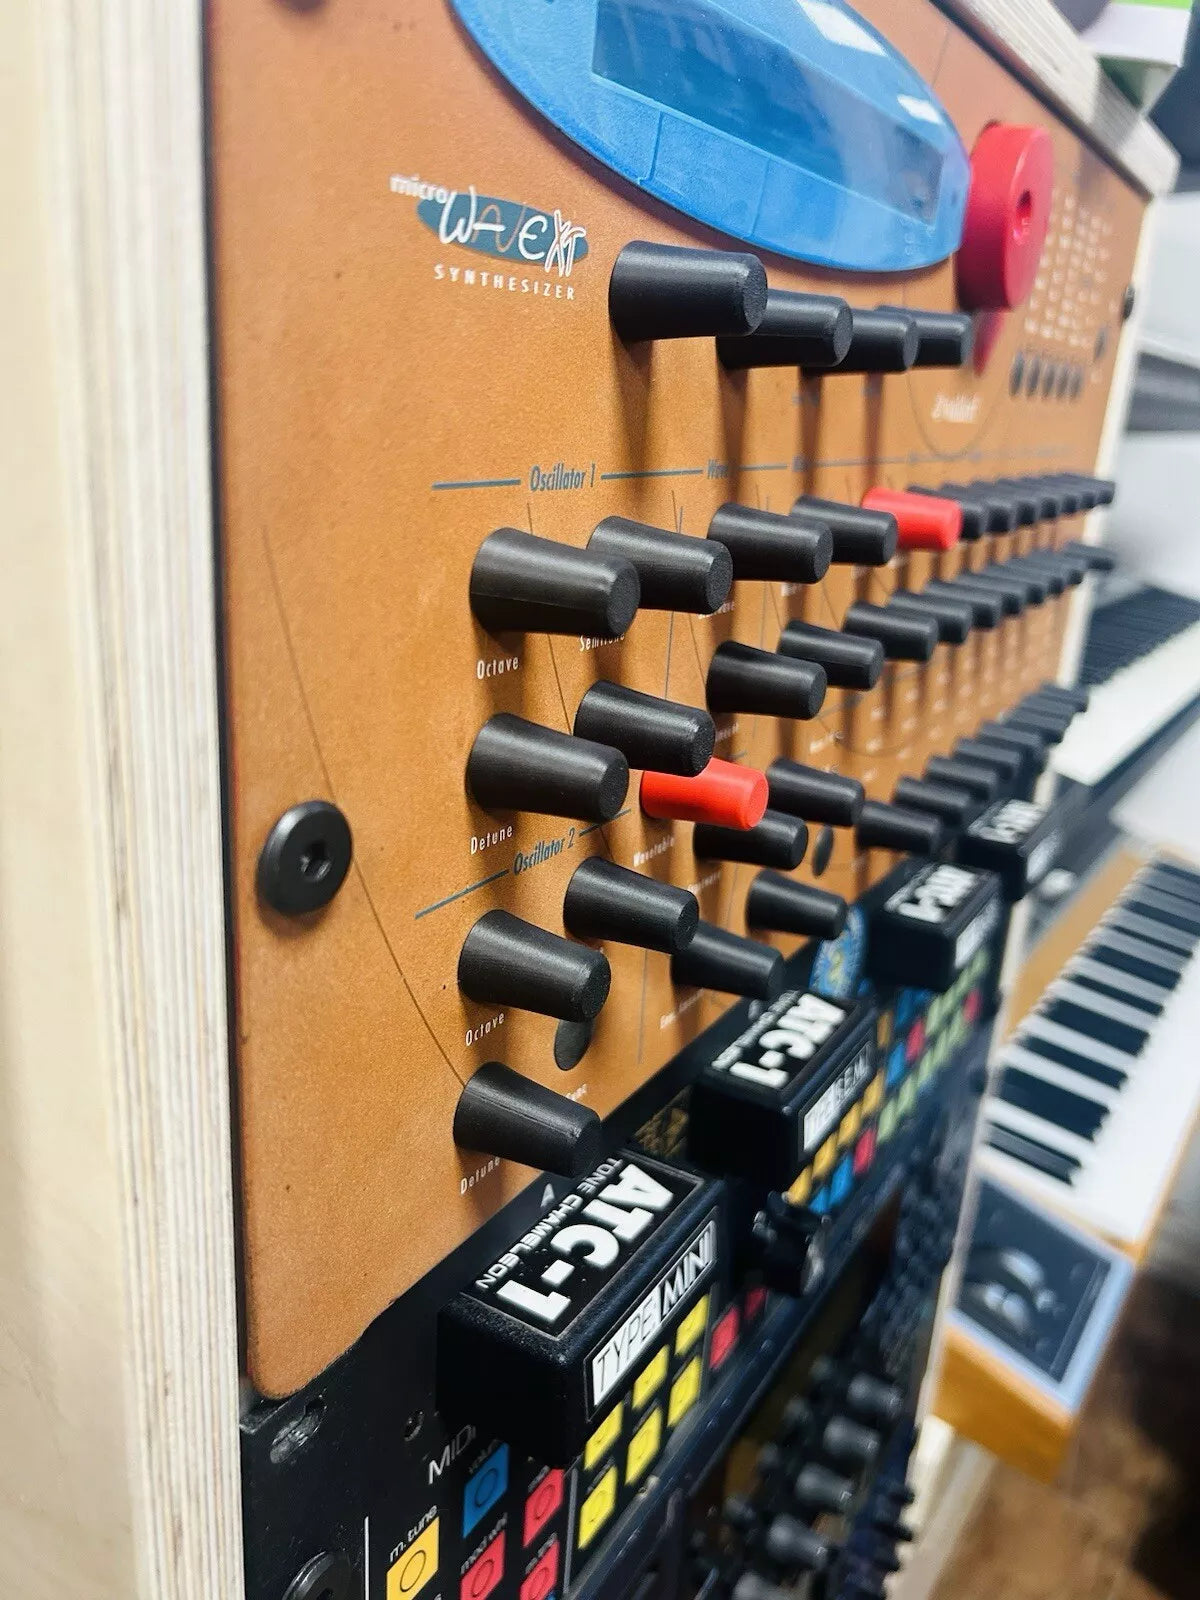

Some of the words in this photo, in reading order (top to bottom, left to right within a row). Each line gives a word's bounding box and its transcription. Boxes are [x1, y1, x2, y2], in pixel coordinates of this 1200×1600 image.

[389, 173, 450, 204] micro
[433, 263, 576, 300] SYNTHESIZER
[529, 460, 587, 491] Oscillator
[589, 462, 597, 488] 1
[476, 656, 520, 680] Octave
[470, 823, 514, 855] Detune
[513, 837, 567, 876] Oscillator
[567, 826, 577, 849] 2
[465, 1012, 505, 1047] Octave
[459, 1155, 501, 1196] Detune
[576, 1157, 624, 1195] TONE
[474, 1193, 584, 1291] CHAMELEON
[496, 1163, 674, 1323] ATC-1
[597, 1303, 659, 1392] TYPE
[660, 1220, 717, 1316] MINI
[407, 1504, 438, 1541] tune
